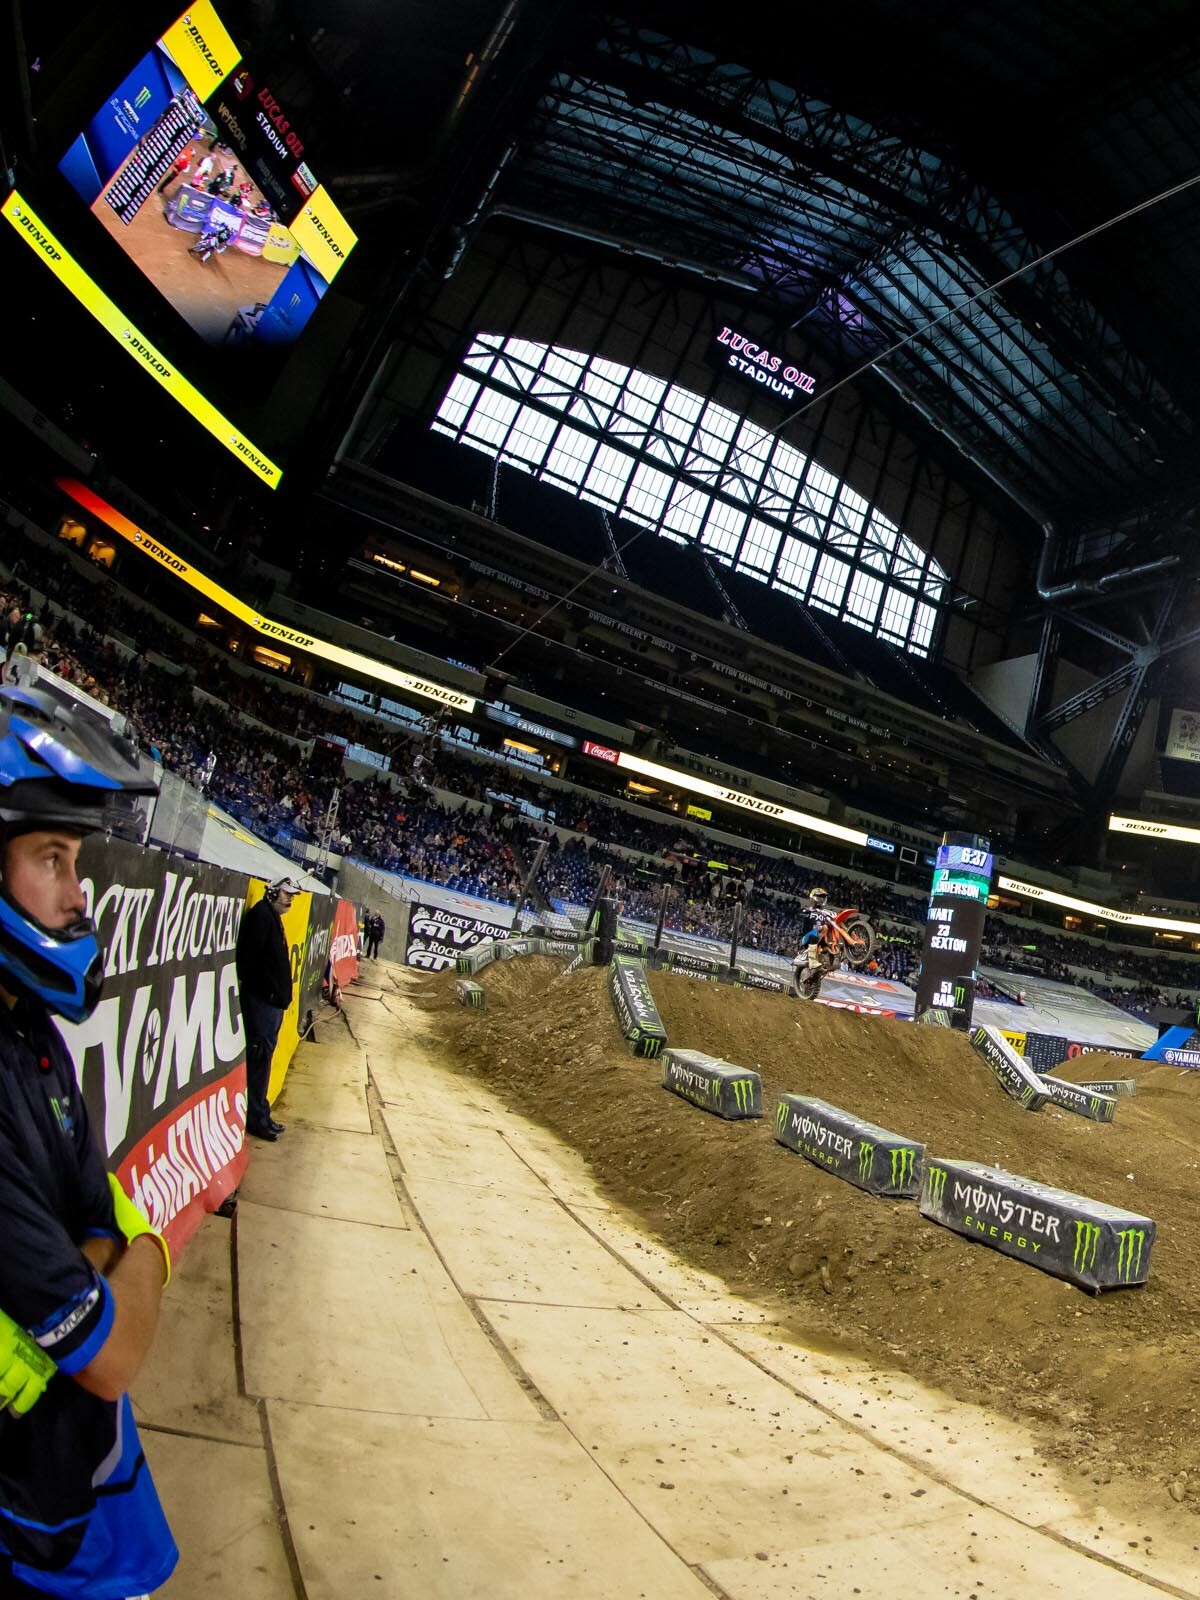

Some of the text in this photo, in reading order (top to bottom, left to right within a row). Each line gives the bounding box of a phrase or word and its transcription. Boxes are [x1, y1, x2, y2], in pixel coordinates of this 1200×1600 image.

[189, 25, 224, 78] DUNLOP
[218, 101, 247, 151] verizon
[256, 111, 288, 160] STADIUM
[257, 88, 290, 134] LUCAS
[286, 131, 304, 159] OIL
[20, 215, 62, 262] DUNLOP
[311, 215, 345, 260] DUNLOP
[130, 338, 171, 379] DUNLOP
[717, 327, 816, 395] LUCAS OIL
[728, 354, 795, 400] STADIUM
[236, 442, 274, 477] DUNLOP
[142, 539, 188, 574] DUNLOP
[589, 611, 615, 629] DWIGHT
[261, 622, 314, 647] DUNLOP
[712, 662, 737, 678] PEYTON
[738, 672, 767, 690] MANNING
[413, 680, 468, 706] DUNLOP
[517, 721, 556, 741] FANDUEL
[826, 707, 847, 722] REGGIE
[849, 717, 867, 731] WAYNE
[726, 792, 784, 816] DUNLOP
[1125, 823, 1167, 834] DUNLOP
[867, 838, 894, 852] GEICO
[961, 848, 987, 867] 6:37
[936, 881, 980, 898] ANDERSON
[1010, 883, 1043, 897] DUNLOP
[432, 910, 510, 939] ROCKY MOUN
[1100, 909, 1132, 922] DUNLOP
[938, 924, 950, 936] 23
[428, 941, 464, 958] ROCK
[931, 936, 967, 953] SEXTON
[672, 966, 708, 980] MONSTER
[677, 955, 709, 968] MONSTER
[624, 969, 649, 1017] MONSTER
[748, 974, 781, 989] MONSTER
[941, 981, 952, 993] 51
[985, 1041, 1022, 1088] MONSTER
[671, 1063, 710, 1094] MONSTER
[675, 1084, 705, 1105] ENERGY
[1044, 1083, 1087, 1105] MONSTER
[791, 1112, 852, 1160] MONSTER
[797, 1140, 840, 1169] ENERGY
[953, 1182, 1061, 1242] MONSTER
[965, 1217, 1041, 1253] ENERGY
